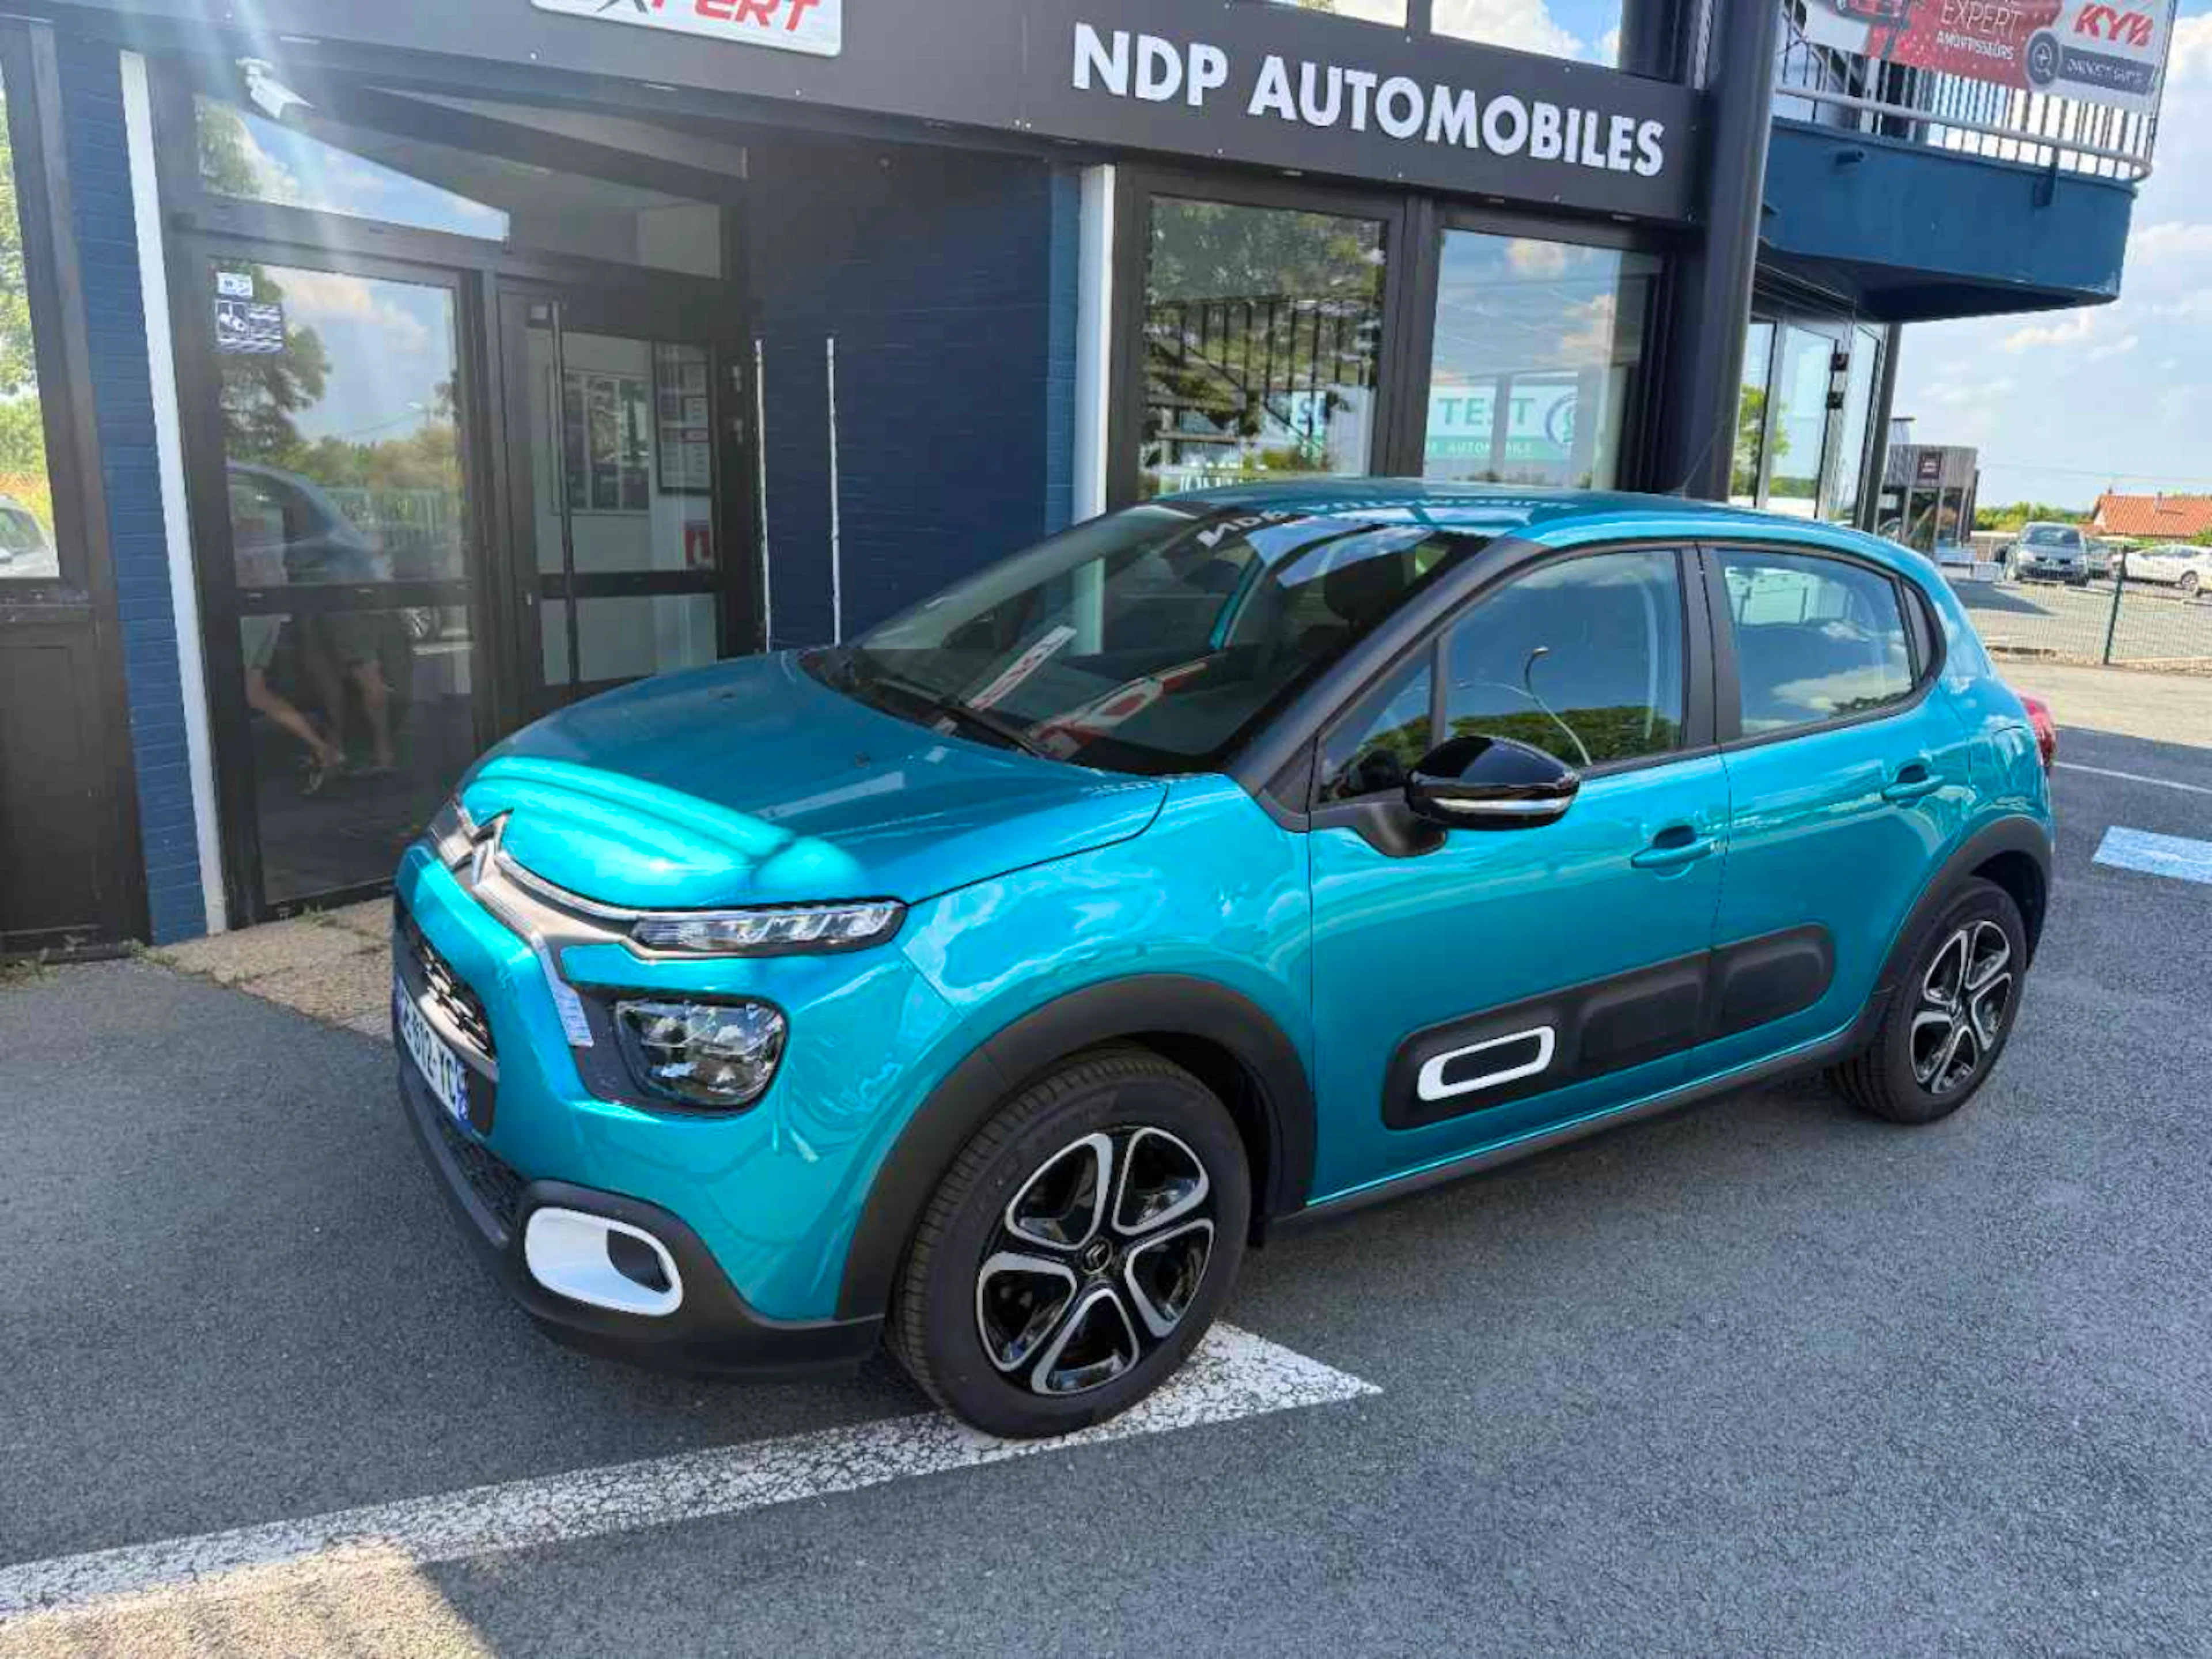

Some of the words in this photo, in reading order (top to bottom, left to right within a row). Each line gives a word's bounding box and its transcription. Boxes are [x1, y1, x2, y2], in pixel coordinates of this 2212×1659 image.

[1940, 0, 2025, 43] EXPERT
[2074, 3, 2154, 47] KYB
[1072, 22, 1229, 106] NDP
[1247, 55, 1664, 177] AUTOMOBILES
[1437, 397, 1535, 426] TET
